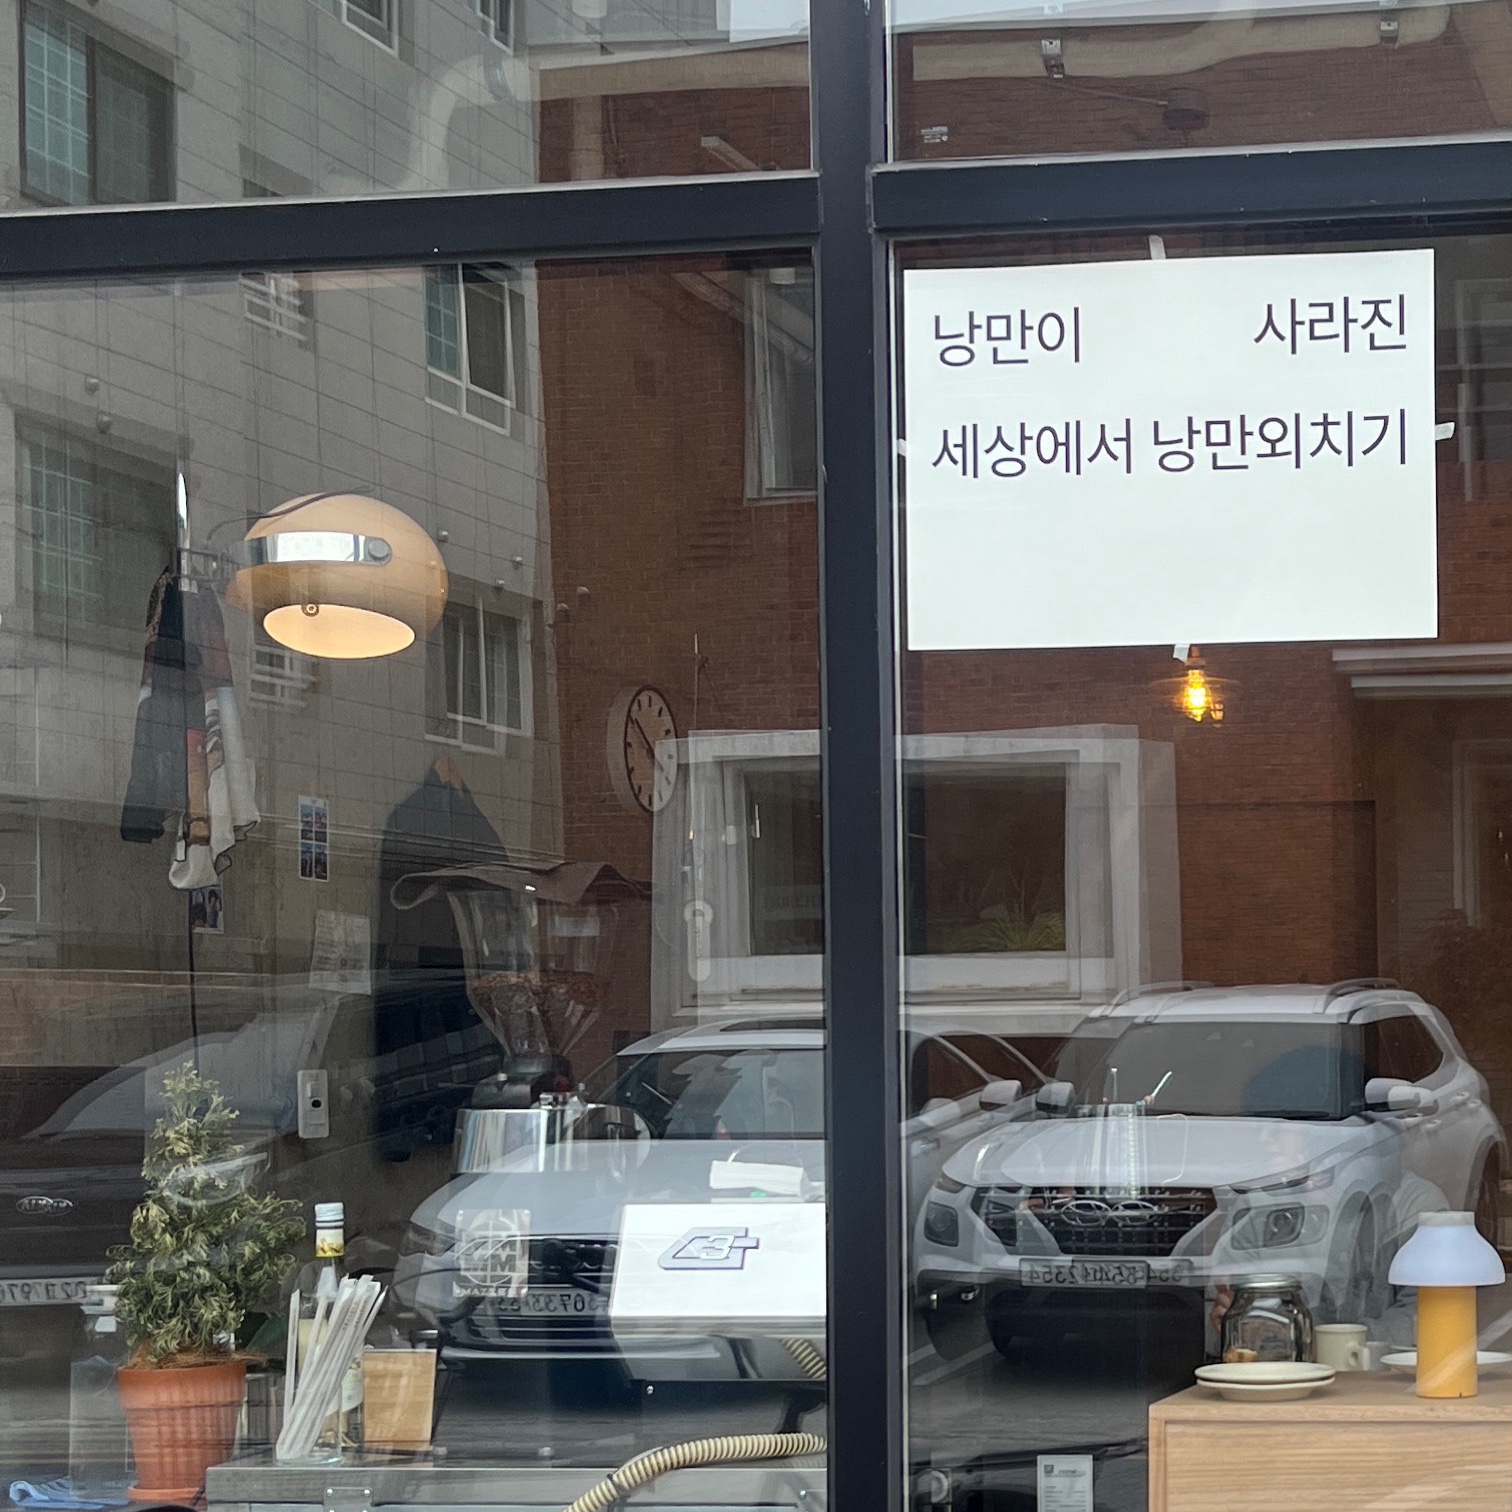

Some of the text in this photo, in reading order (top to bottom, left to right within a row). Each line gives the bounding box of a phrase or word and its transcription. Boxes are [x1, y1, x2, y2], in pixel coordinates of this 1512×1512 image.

[933, 293, 1408, 368] 낭만이 사라진
[931, 407, 1408, 479] 세상에서 낭만외치기
